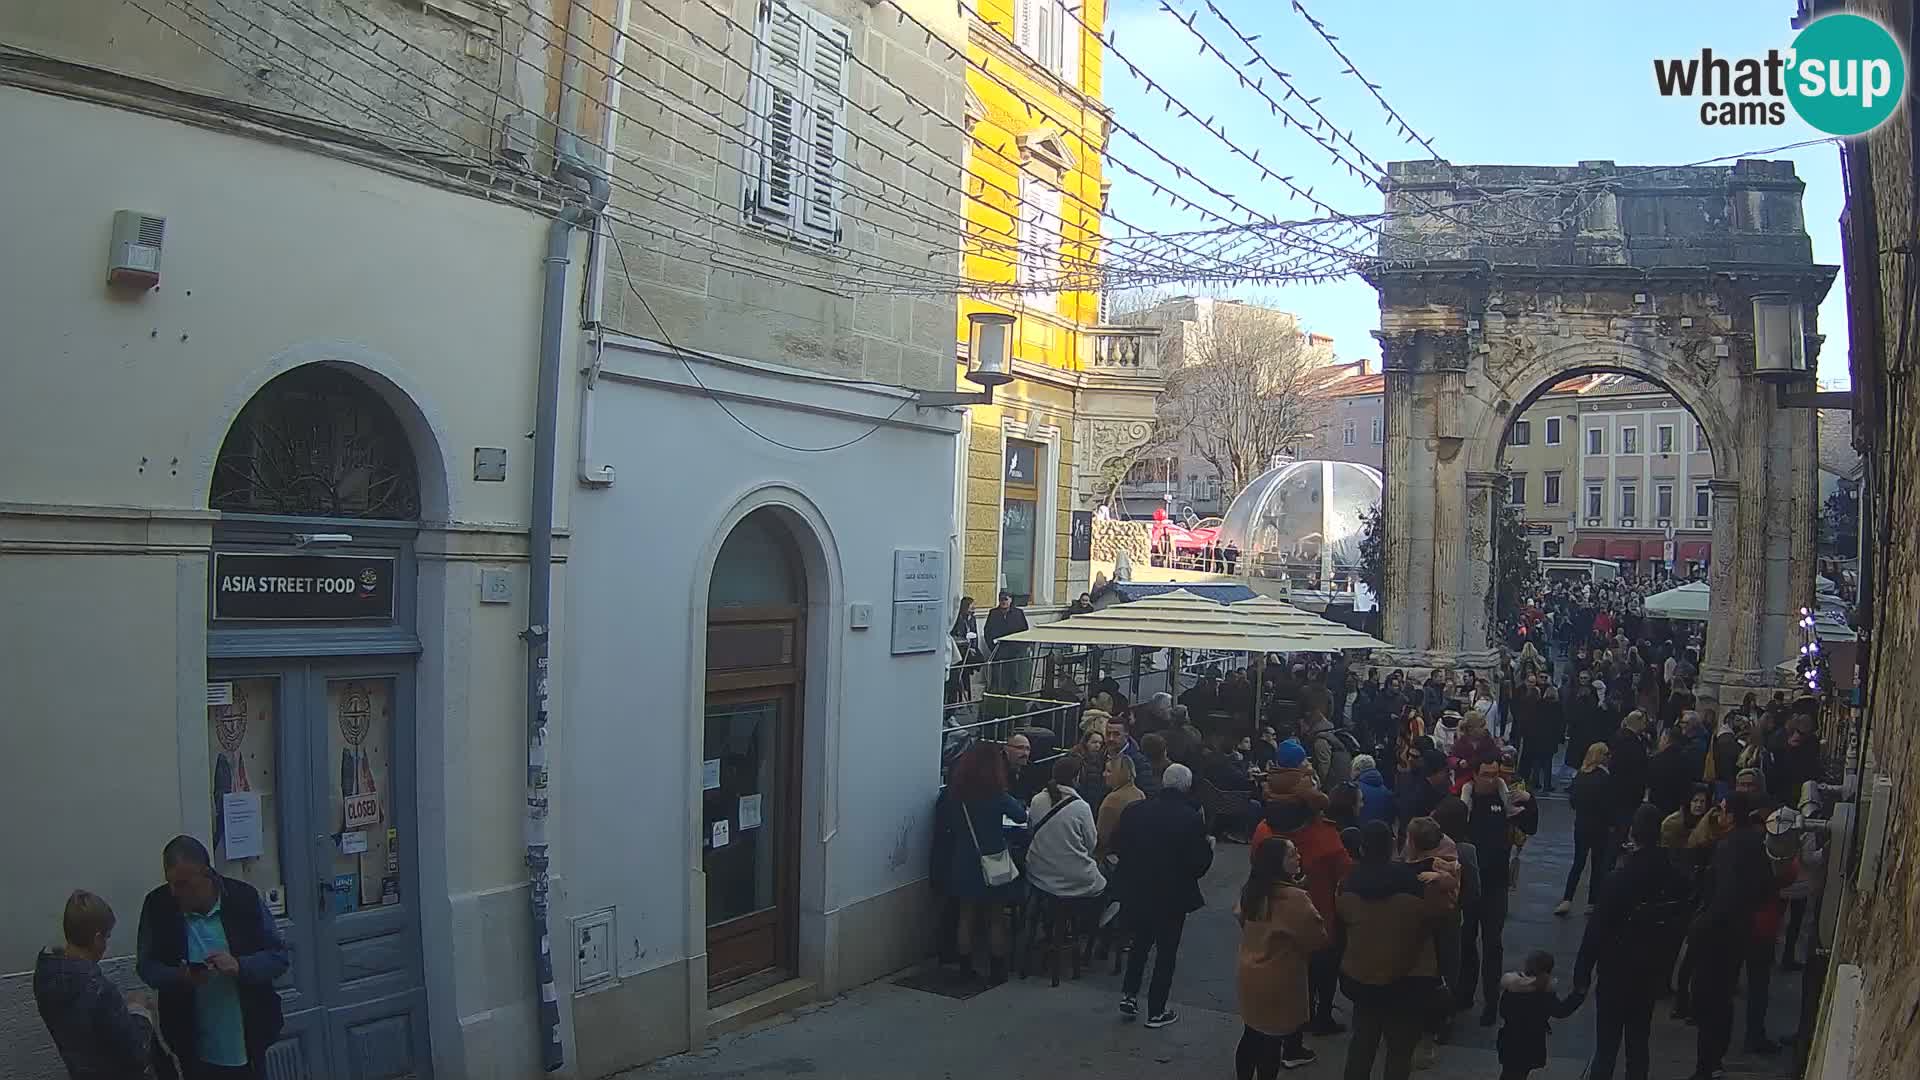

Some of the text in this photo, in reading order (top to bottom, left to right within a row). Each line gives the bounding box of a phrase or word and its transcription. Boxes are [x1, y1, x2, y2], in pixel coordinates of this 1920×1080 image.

[222, 575, 356, 593] ASIA STREET FOOD
[348, 799, 377, 819] CLOSED
